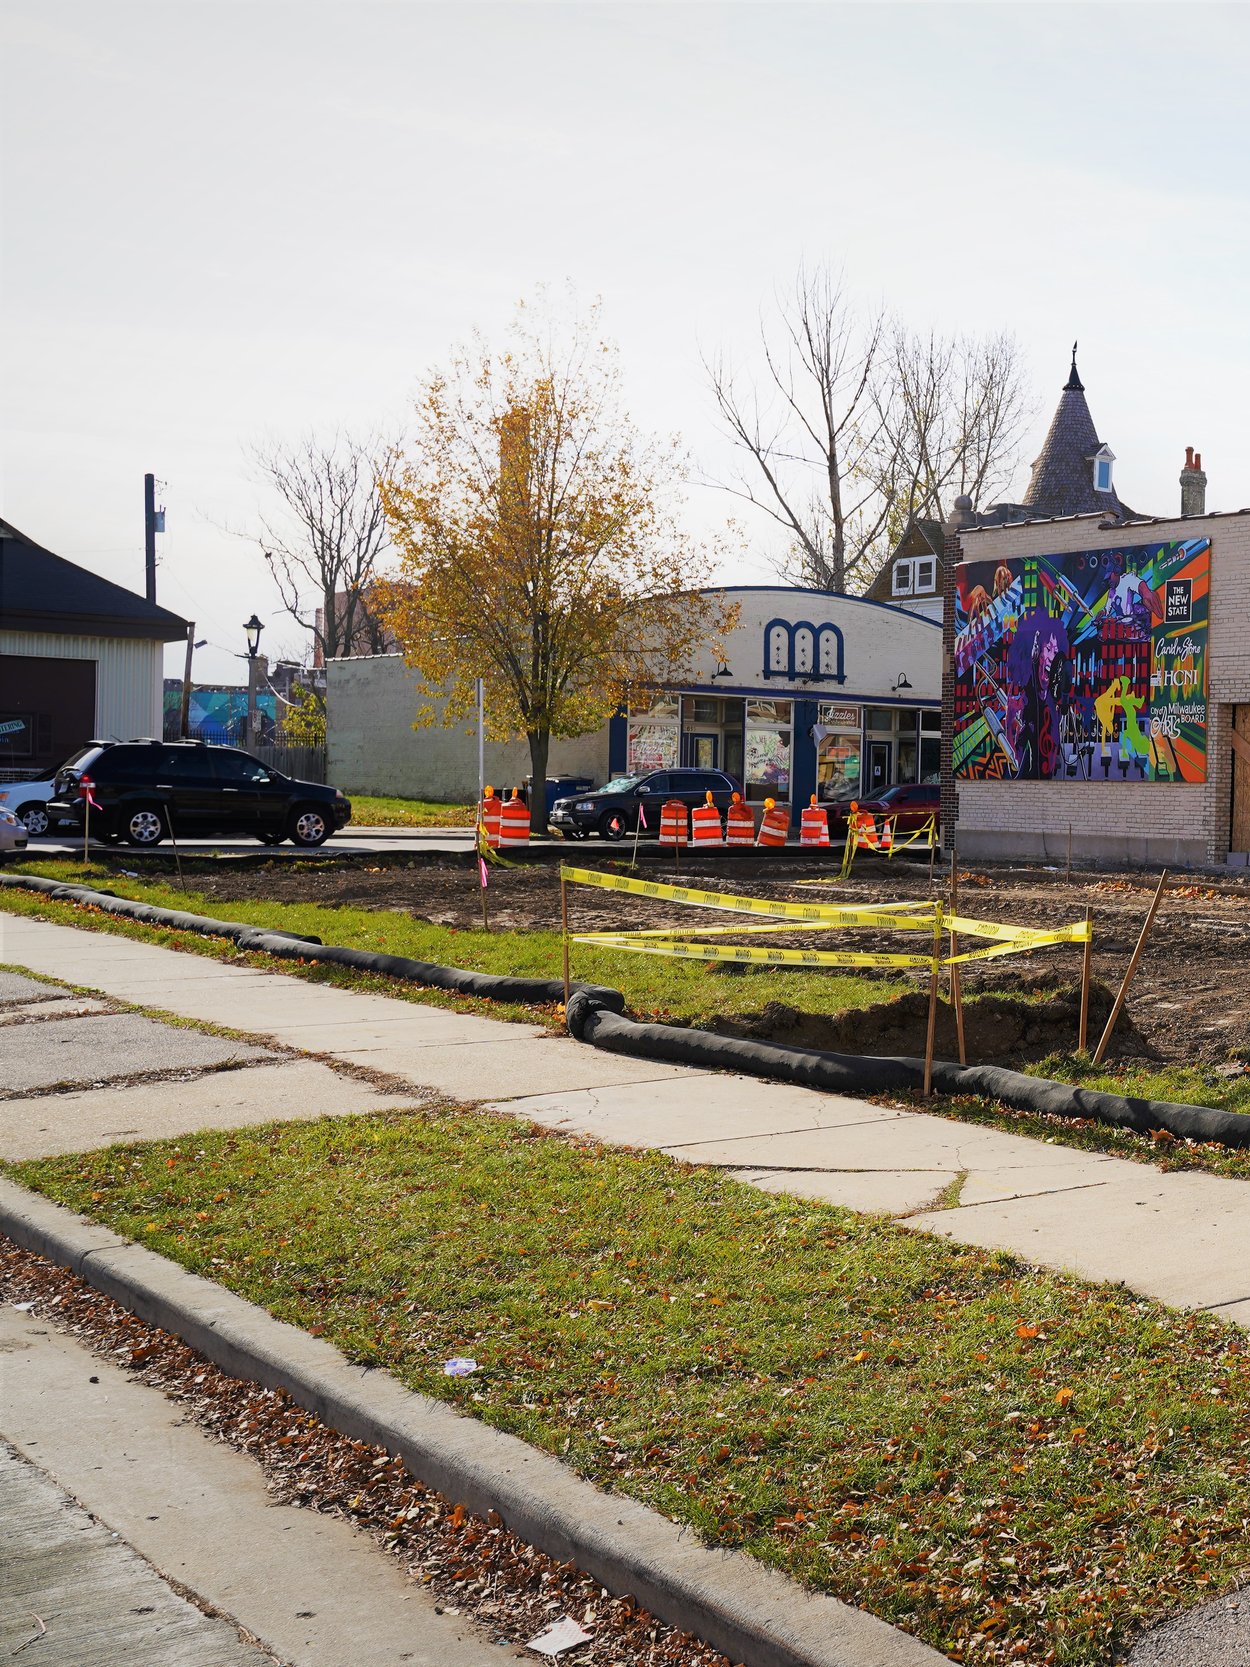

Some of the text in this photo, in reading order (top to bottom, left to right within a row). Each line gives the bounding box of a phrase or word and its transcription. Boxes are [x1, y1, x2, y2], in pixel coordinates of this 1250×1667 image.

[1173, 586, 1184, 594] THE
[1168, 594, 1189, 606] NEW
[1168, 606, 1187, 617] STATE
[1164, 669, 1198, 687] HCNI
[1168, 701, 1206, 715] Milwaukee
[1180, 714, 1205, 724] BOARD
